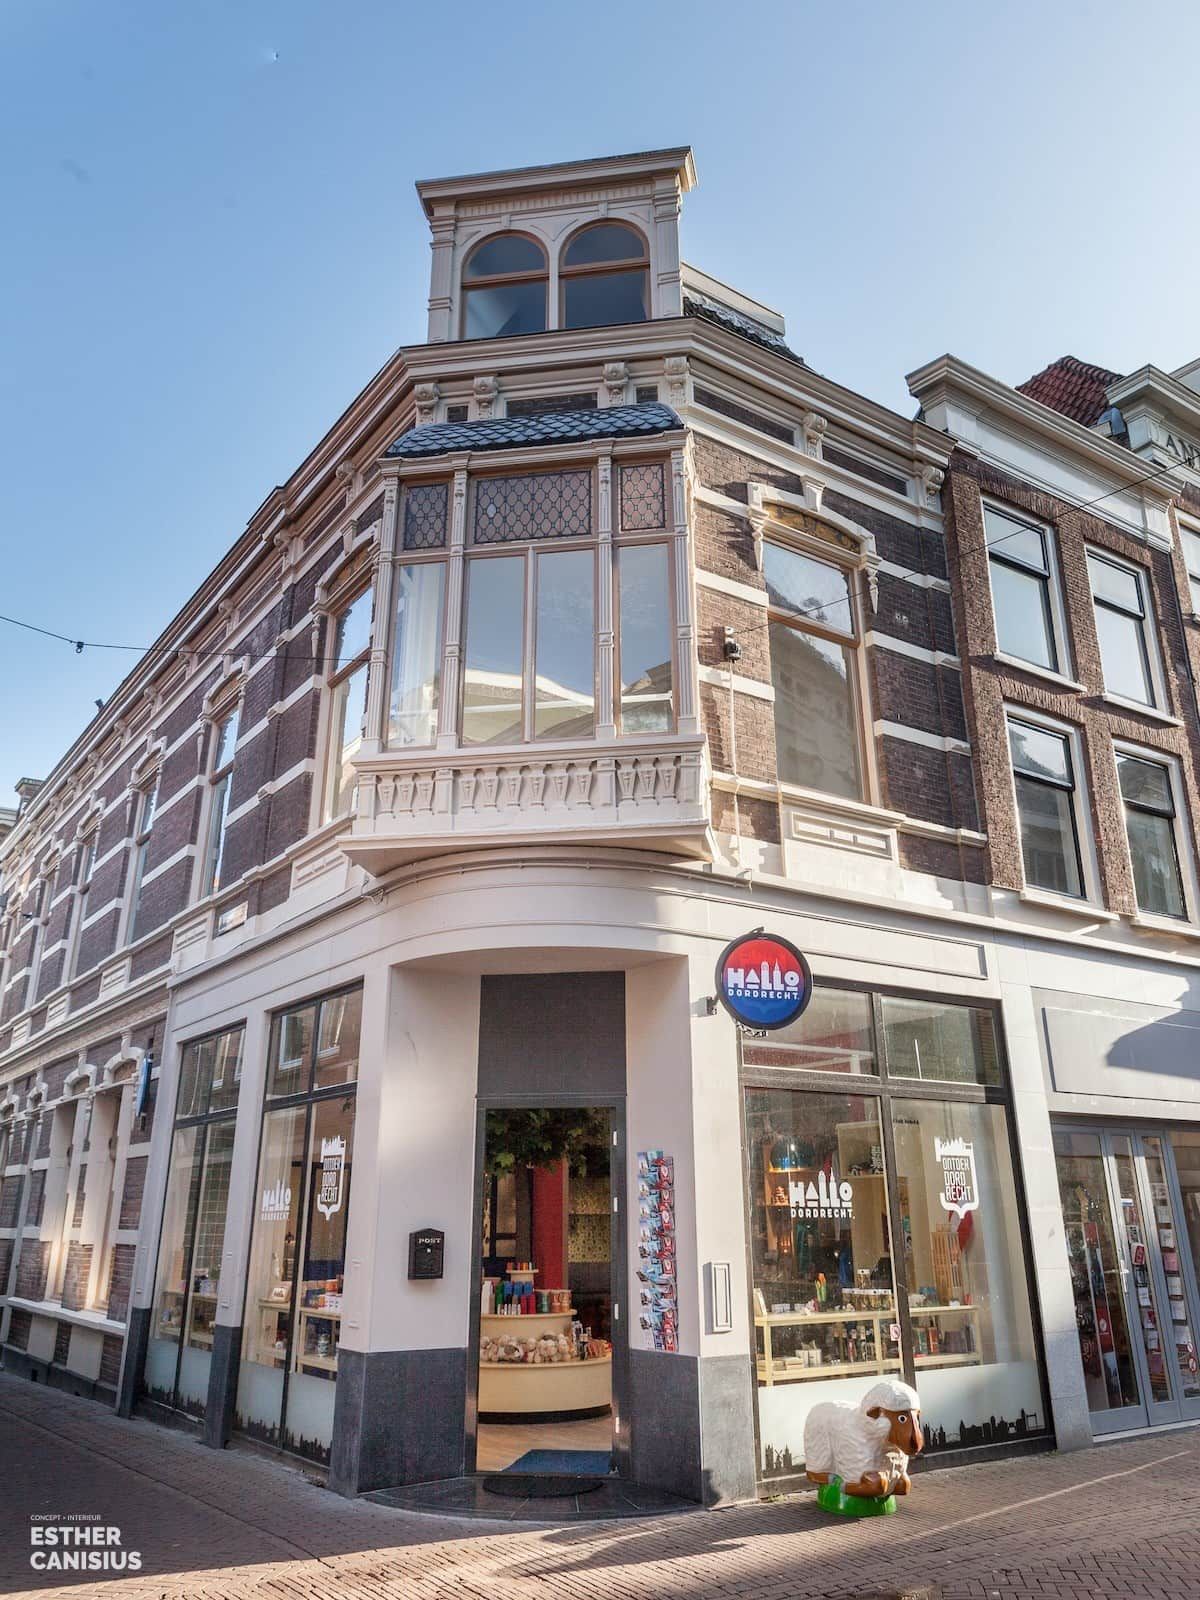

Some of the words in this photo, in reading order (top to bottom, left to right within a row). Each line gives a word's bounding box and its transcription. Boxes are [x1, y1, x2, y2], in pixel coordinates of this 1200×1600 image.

[1166, 434, 1200, 469] AN
[727, 958, 799, 991] HALLO
[942, 1157, 970, 1170] ONTDEK
[943, 1171, 966, 1186] DORD
[789, 1167, 853, 1208] HALLO
[945, 1186, 972, 1201] RECHT
[418, 1237, 441, 1245] POST
